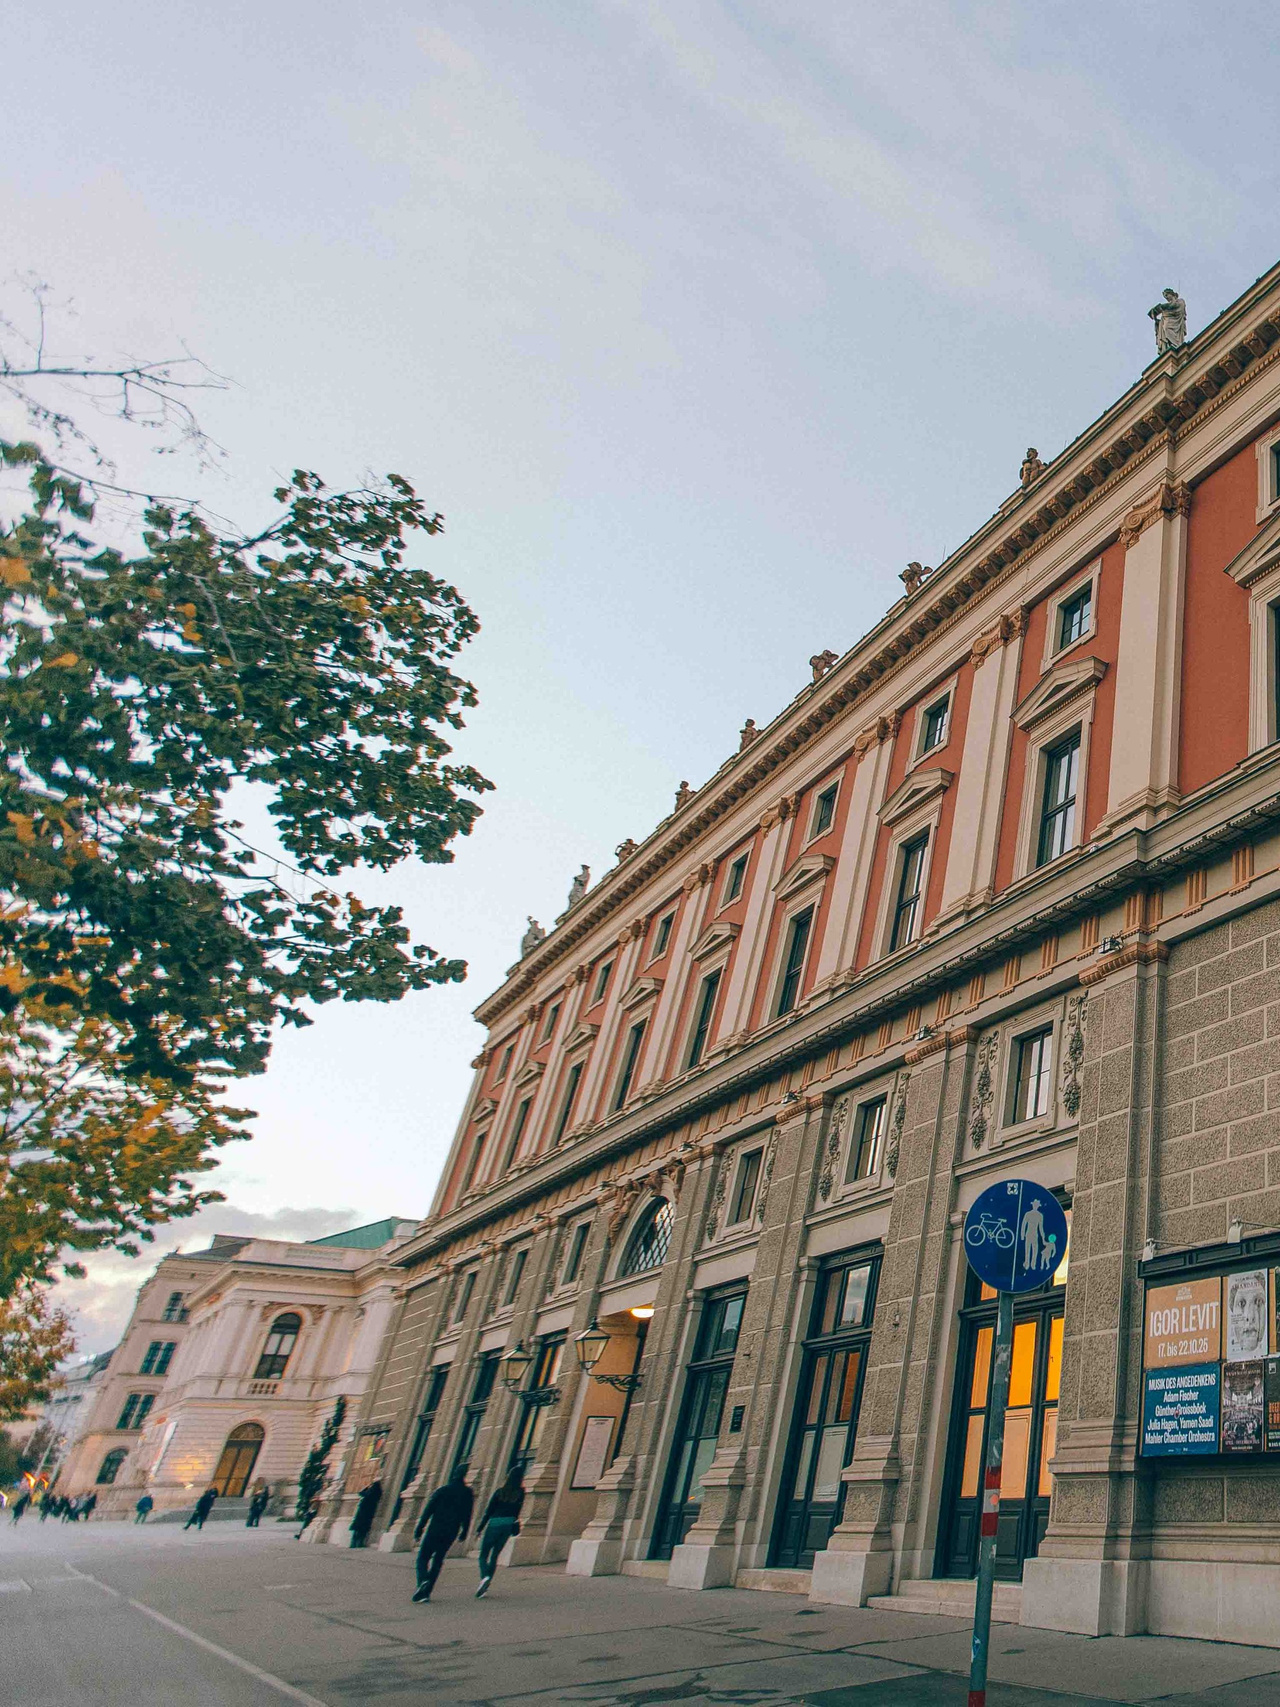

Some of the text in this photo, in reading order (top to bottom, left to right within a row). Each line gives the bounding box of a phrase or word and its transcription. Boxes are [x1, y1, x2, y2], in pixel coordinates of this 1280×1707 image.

[1150, 1301, 1219, 1338] IGOR LEVIT
[1158, 1337, 1208, 1358] 17. bis 22.10.25
[1149, 1378, 1166, 1391] MUSIK
[1166, 1376, 1176, 1389] DES
[1176, 1373, 1216, 1388] ANGEDENKENS
[1163, 1389, 1199, 1402] Adam Fischer
[1147, 1415, 1214, 1432] Julia Hagen, Yamen Saadi
[1145, 1432, 1163, 1444] Mahler
[1163, 1430, 1188, 1444] Chamber
[1188, 1430, 1215, 1443] Orchestra
